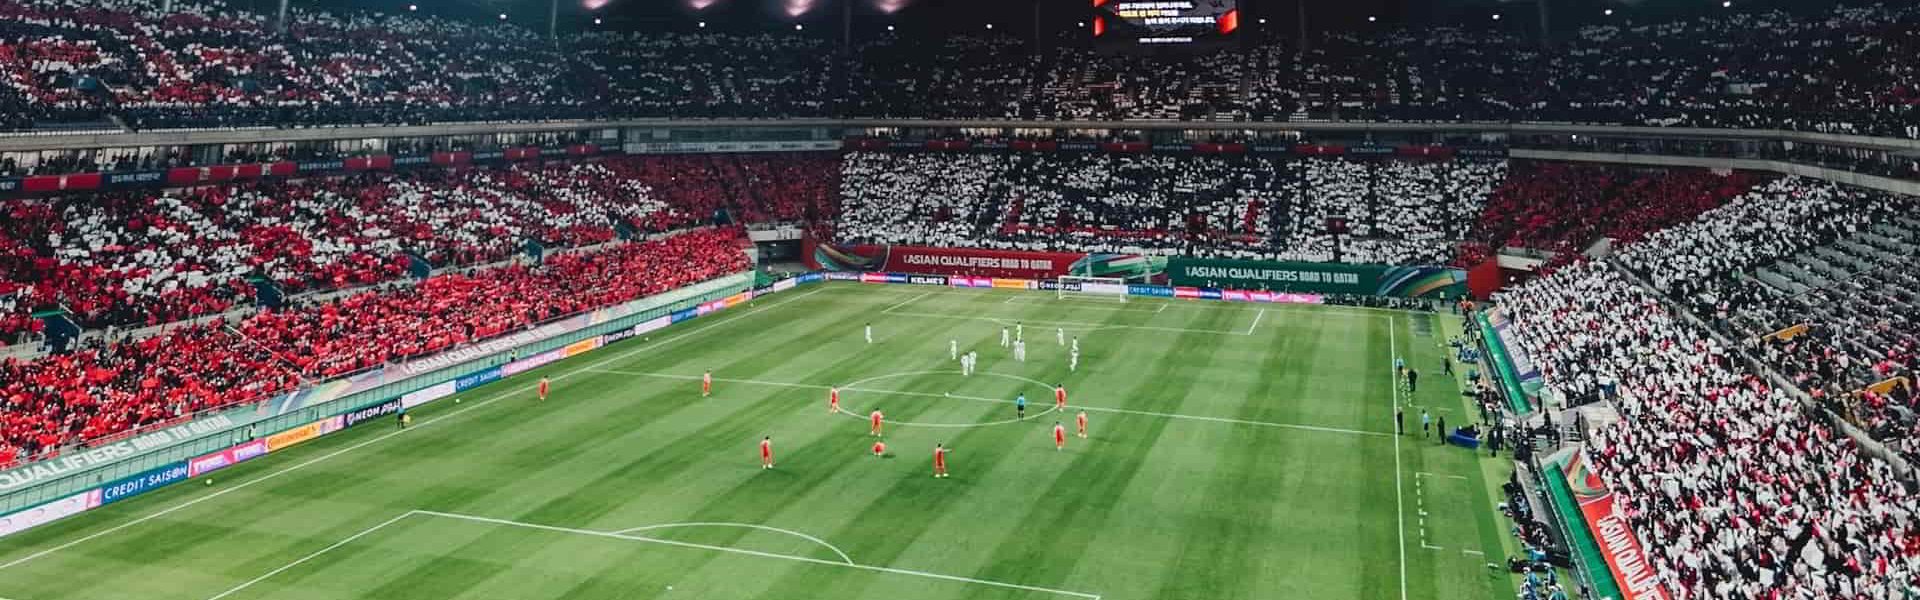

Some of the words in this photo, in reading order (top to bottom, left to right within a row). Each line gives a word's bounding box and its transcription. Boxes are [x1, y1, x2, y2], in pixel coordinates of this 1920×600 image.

[907, 255, 940, 264] ASIAN
[940, 255, 1000, 268] QUALIFIERS
[1191, 266, 1227, 278] ASIAN
[1228, 268, 1298, 281] QUALIFIERS
[1299, 271, 1320, 282] ROAD
[1322, 272, 1331, 283] TO
[1334, 273, 1358, 284] QATAR
[354, 405, 379, 421] NEOM
[0, 441, 133, 488] QUALIFIERS
[104, 478, 145, 499] CREDIT
[1600, 519, 1632, 555] ASIAN
